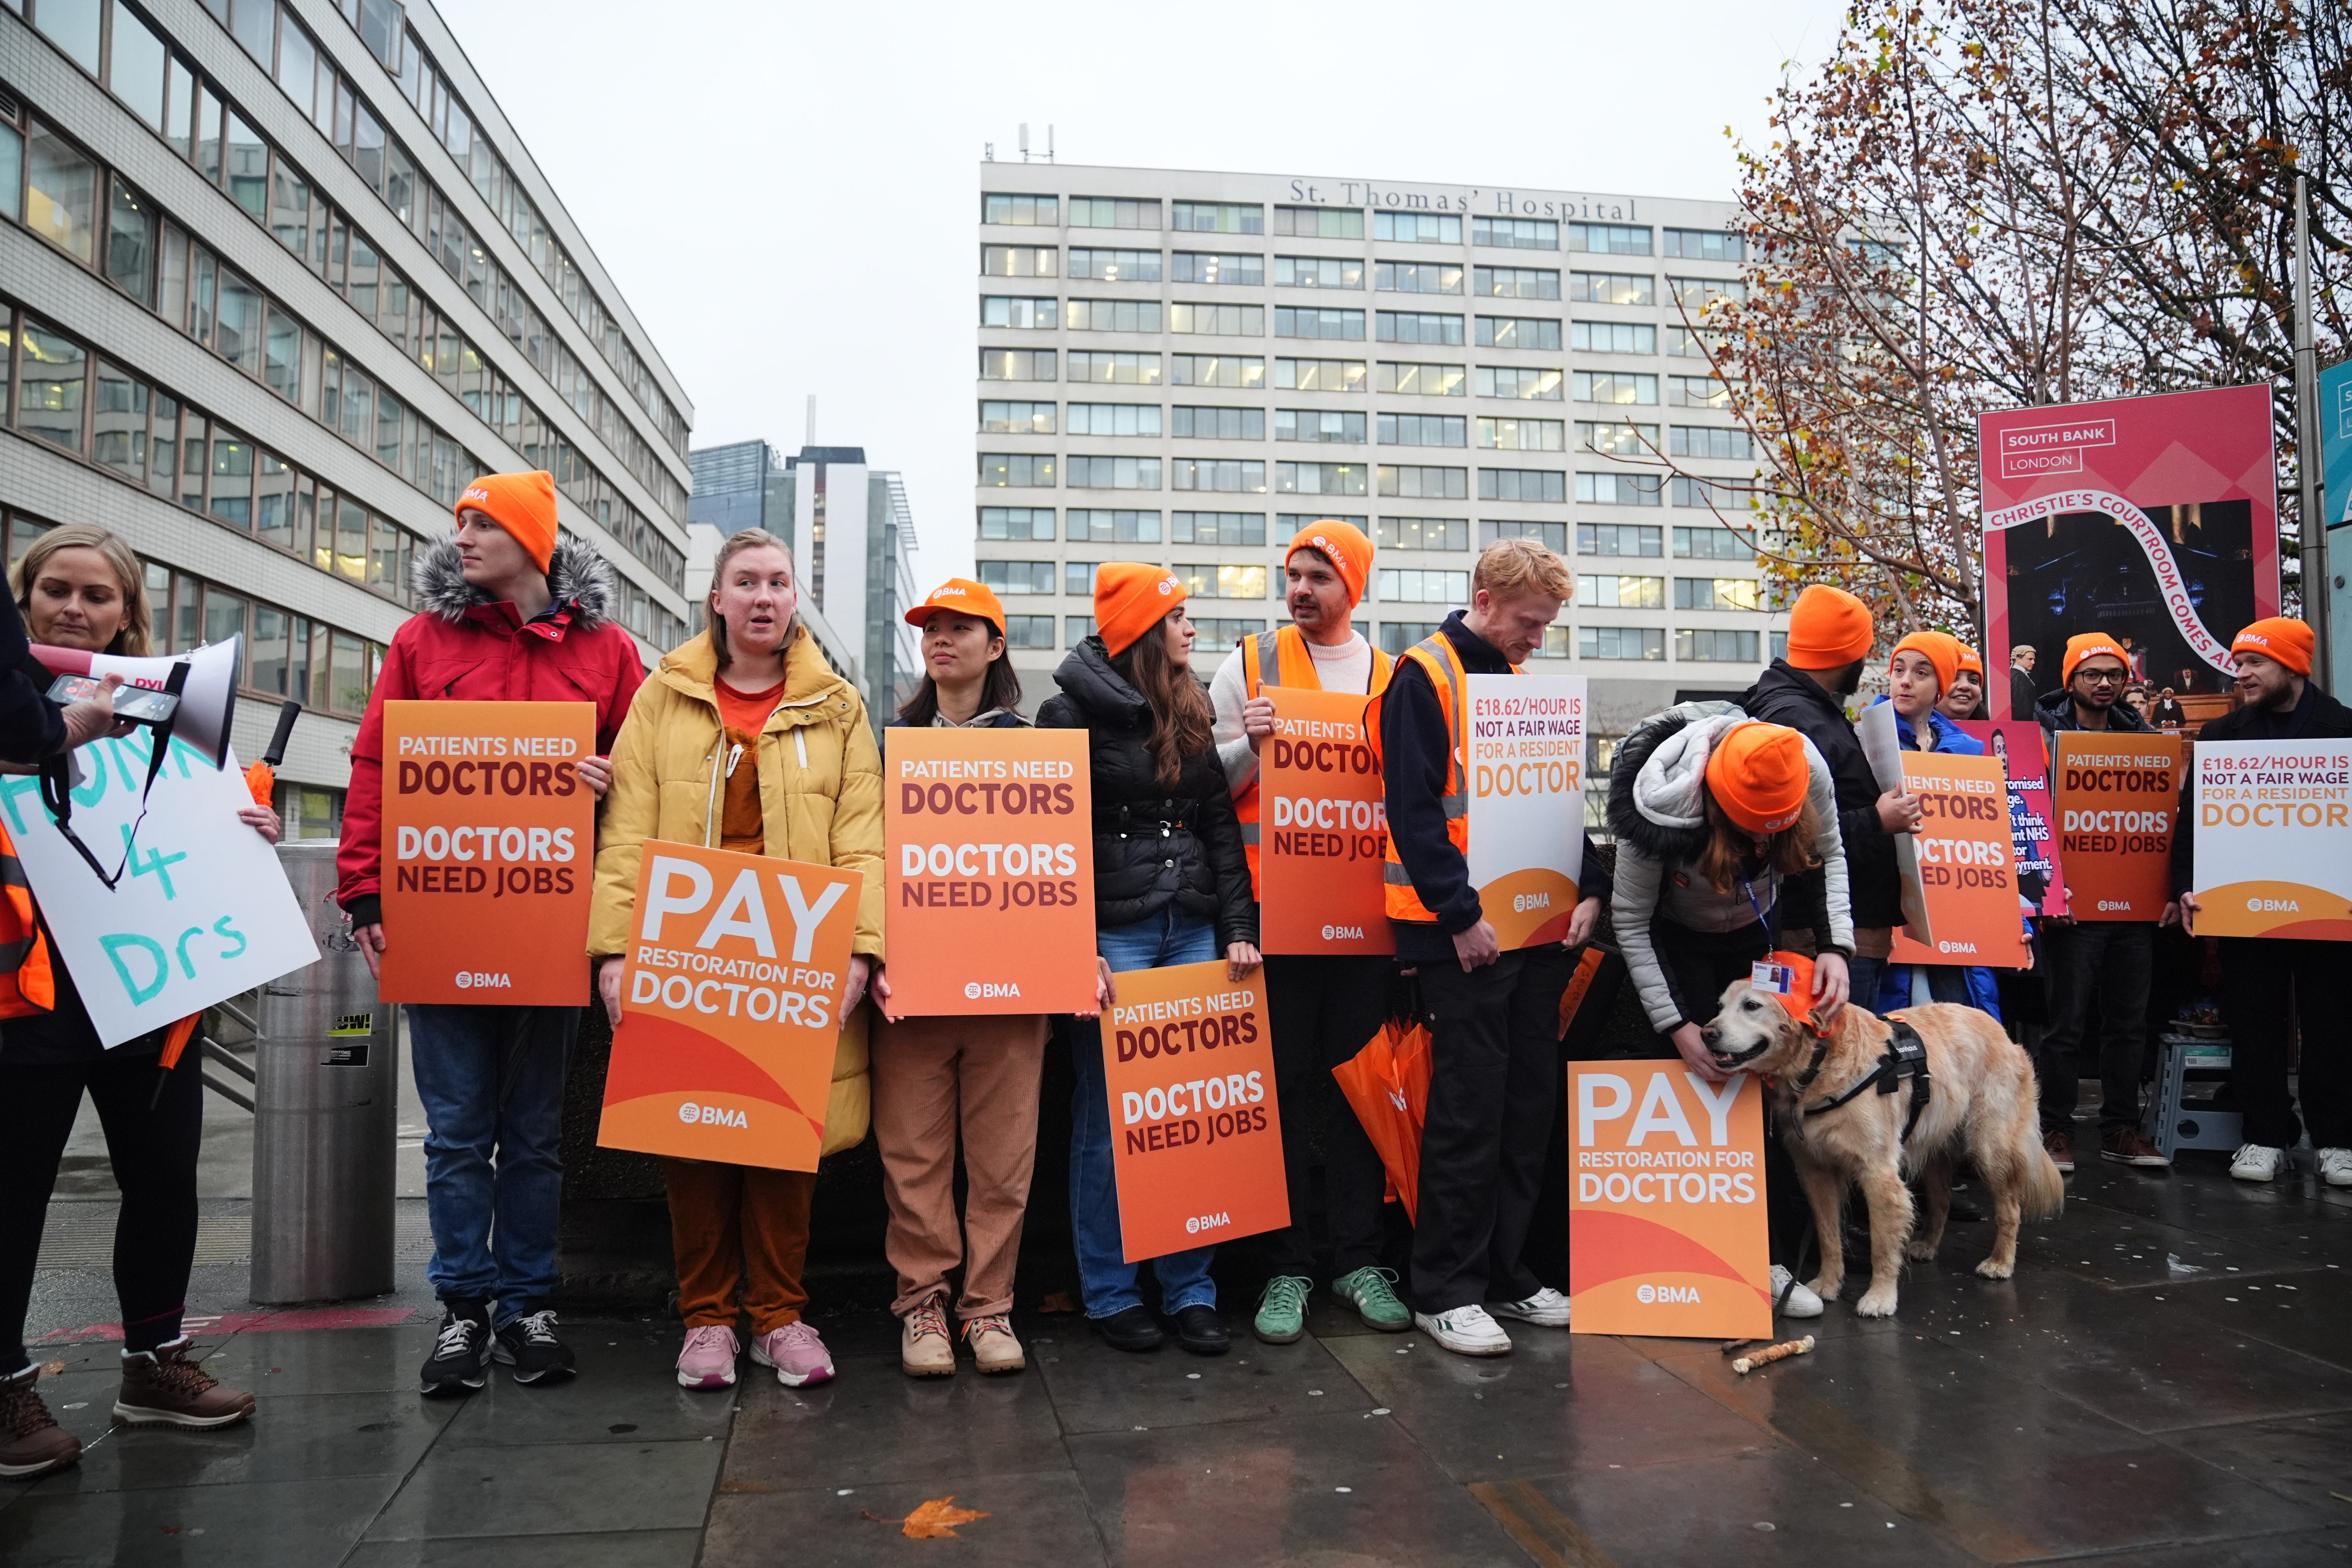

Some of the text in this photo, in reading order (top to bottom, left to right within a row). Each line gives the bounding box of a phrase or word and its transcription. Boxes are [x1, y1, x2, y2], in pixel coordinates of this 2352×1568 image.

[1290, 180, 1636, 224] St. Thomas' Hospital
[2009, 428, 2105, 446] SOUTH BANK
[2011, 455, 2072, 470] LONDON
[1326, 543, 1348, 572] BMA
[1991, 493, 2092, 526] CHRISTIE'S
[2100, 497, 2178, 590] COURTROOM
[2170, 593, 2212, 652] COMES
[942, 587, 966, 597] BMA
[2090, 646, 2114, 654] BMA
[2244, 634, 2269, 647] BMA
[1964, 653, 1976, 661] MA
[1475, 697, 1581, 717] £18.62/HOUR IS
[1275, 718, 1355, 740] PATIENTS
[1476, 720, 1581, 738] NOT A FAIR WAGE
[399, 737, 577, 757] PATIENTS NEED
[1274, 739, 1381, 775] DOCTO
[1476, 740, 1580, 760] FOR A RESIDENT
[901, 760, 1073, 778] PATIENTS NEED
[2067, 754, 2171, 768] PATIENTS NEED
[2203, 756, 2349, 770] £18.62/HOUR IS
[399, 761, 576, 796] DOCTORS
[1477, 761, 1580, 797] DOCTOR
[1955, 779, 1995, 793] NEED
[2005, 775, 2044, 790] romised
[2066, 769, 2170, 792] DOCTORS
[2202, 772, 2349, 785] NOT A FAIR WAGE
[902, 783, 1074, 815] DOCTORS
[2007, 794, 2024, 806] ge.
[2202, 788, 2349, 800] FOR A RESIDENT
[1274, 797, 1387, 831] DOCTOR
[1918, 793, 1998, 821] CTORS
[2202, 803, 2349, 827] DOCTOR
[2015, 811, 2045, 826] think
[2064, 810, 2168, 833] DOCTORS
[397, 826, 575, 862] DOCTORS
[2026, 827, 2049, 841] NHS
[2063, 835, 2167, 855] NEED JOBS
[1275, 832, 1387, 862] NEED JOB
[1914, 838, 2005, 866] CTORS
[120, 823, 187, 900] 4
[902, 843, 1076, 877] DOCTORS
[397, 866, 574, 898] NEED JOBS
[1922, 866, 2007, 889] ED JOBS
[902, 881, 1078, 911] NEED JOBS
[1526, 892, 1549, 910] BMA
[2109, 901, 2131, 911] BMA
[2264, 900, 2299, 912] BMA
[641, 855, 849, 963] PAY
[1336, 926, 1364, 939] BMA
[1952, 942, 1977, 953] BMA
[99, 915, 247, 1006] Drs
[637, 946, 835, 990] RESTORATION FOR
[474, 973, 512, 987] BMA
[983, 983, 1021, 997] BMA
[631, 970, 831, 1029] DOCTORS
[1113, 990, 1254, 1025] PATIENTS NEED
[1116, 1012, 1258, 1063] DOCTORS
[1122, 1071, 1264, 1125] DOCTORS
[701, 1106, 748, 1129] BMA
[1577, 1072, 1748, 1147] PAY
[1126, 1106, 1267, 1155] NEED JOBS
[1579, 1151, 1754, 1167] RESTORATION FOR
[1579, 1172, 1755, 1203] DOCTORS
[1201, 1212, 1230, 1230] BMA
[1658, 1286, 1700, 1303] BMA
